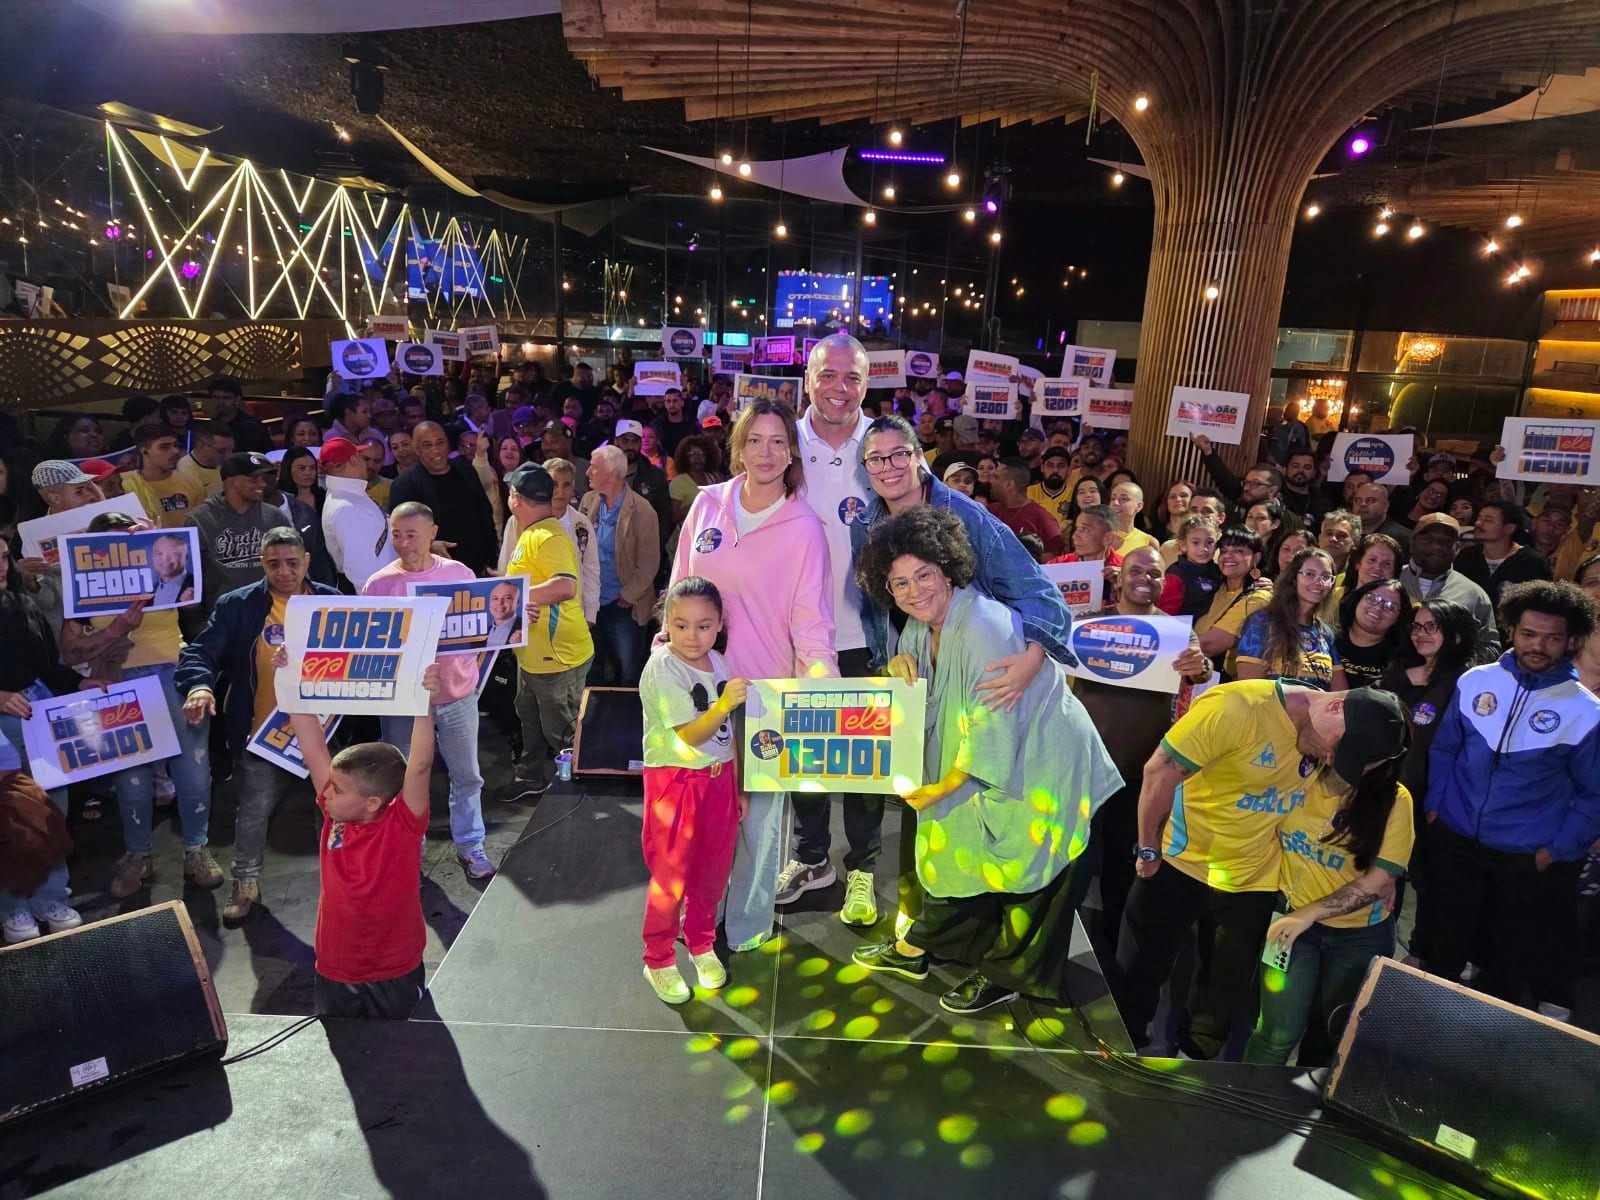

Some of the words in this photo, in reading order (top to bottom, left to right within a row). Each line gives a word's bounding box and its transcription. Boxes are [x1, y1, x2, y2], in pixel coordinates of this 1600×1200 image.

[974, 402, 1008, 414] 12001
[1560, 435, 1592, 450] ele
[1520, 452, 1591, 475] 12001
[74, 542, 148, 571] Gallo
[75, 568, 154, 598] 12001
[306, 607, 413, 649] 12001
[1084, 623, 1122, 632] QUEM
[303, 656, 344, 685] ele
[347, 654, 401, 680] COM
[300, 680, 395, 698] FECHADO
[784, 692, 891, 708] FECHADO
[103, 703, 141, 726] ele
[784, 709, 837, 733] COM
[844, 705, 891, 730] ele
[57, 723, 153, 773] 12001
[780, 738, 892, 779] 12001
